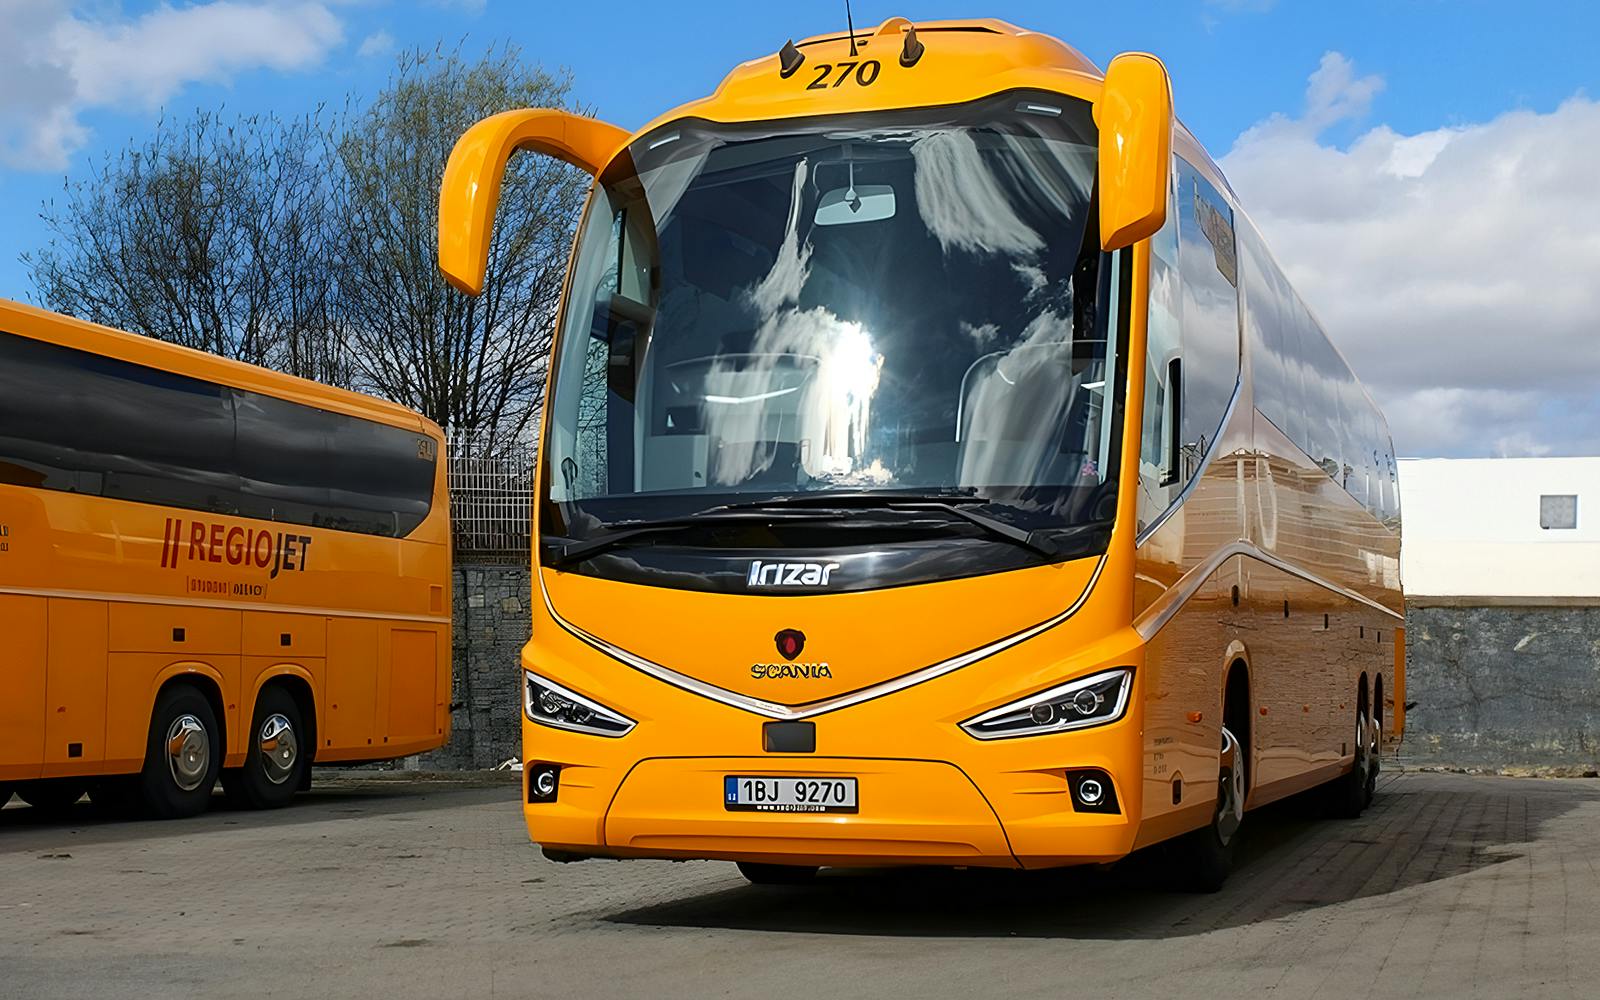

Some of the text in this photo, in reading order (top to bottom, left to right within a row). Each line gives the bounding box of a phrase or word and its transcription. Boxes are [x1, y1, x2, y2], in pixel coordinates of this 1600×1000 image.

[806, 60, 881, 90] 270
[188, 521, 312, 579] REGIOJET
[748, 560, 840, 586] Irizar
[751, 663, 832, 679] SCANIA
[743, 780, 846, 803] 1BJ 9270
